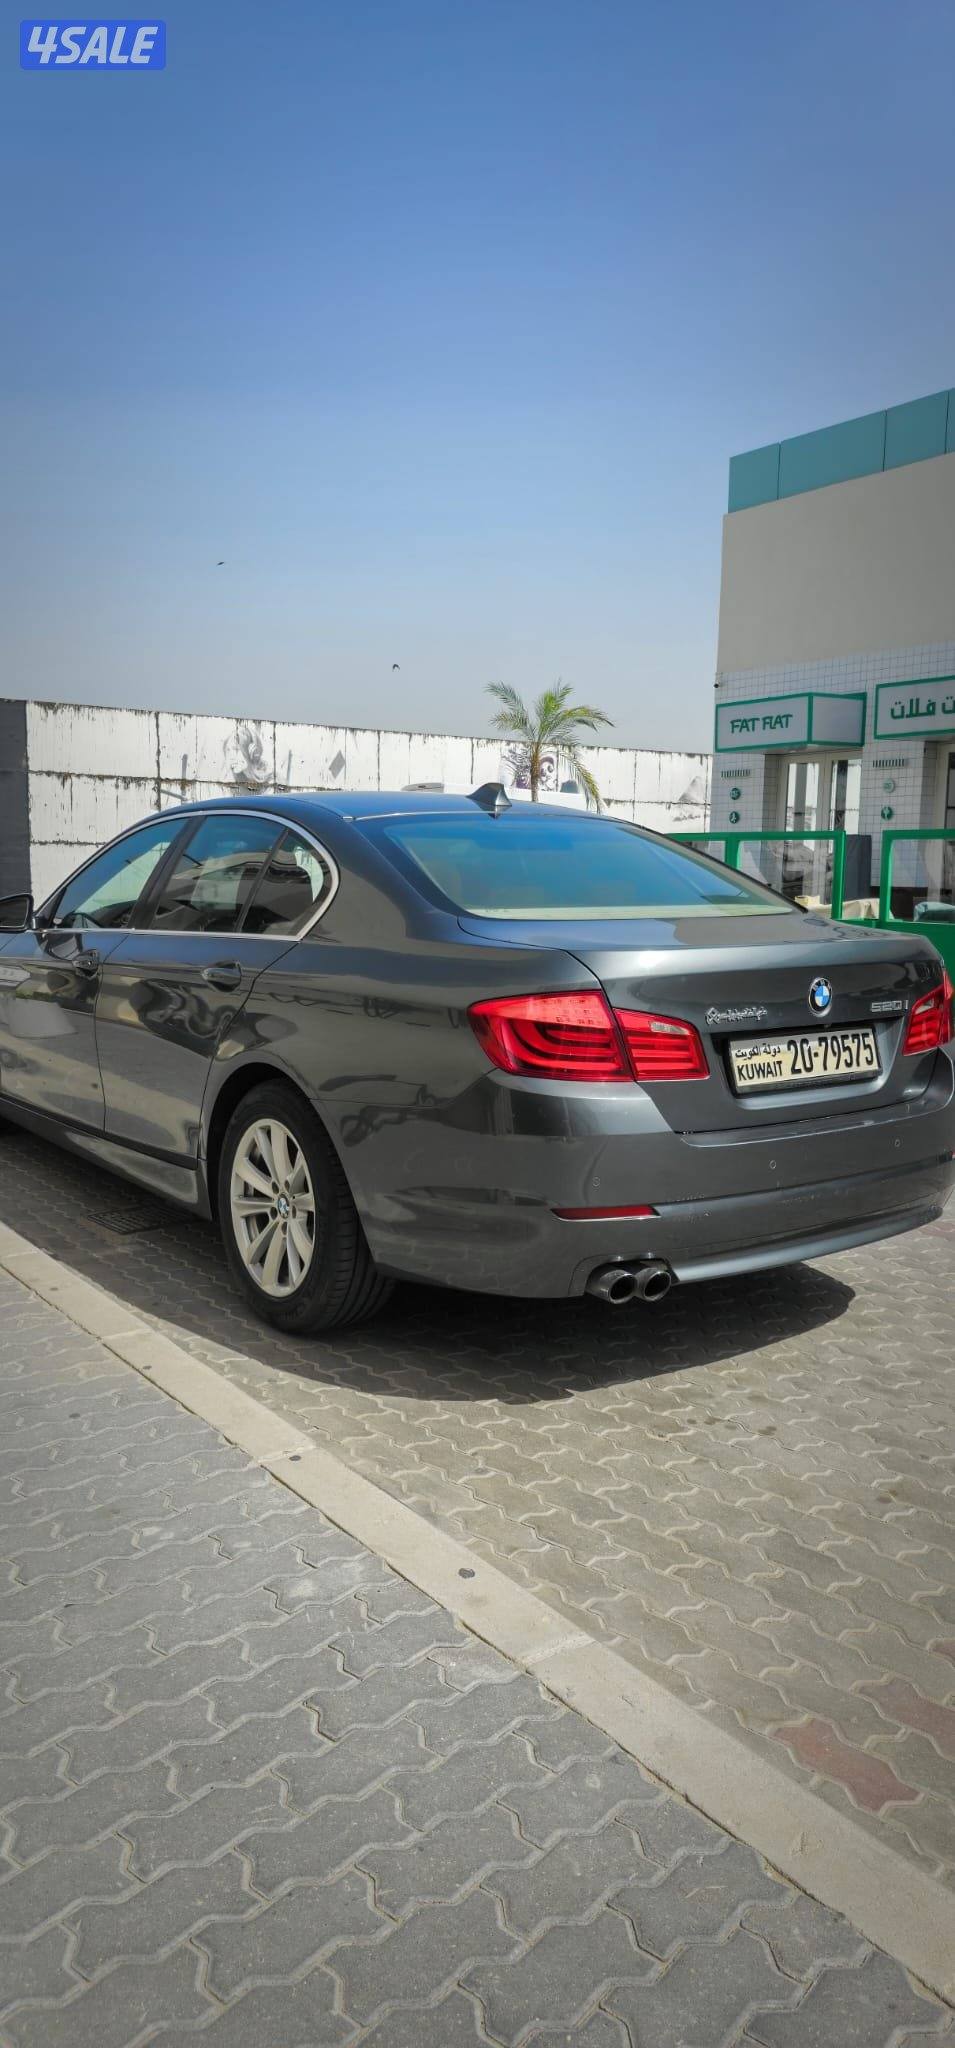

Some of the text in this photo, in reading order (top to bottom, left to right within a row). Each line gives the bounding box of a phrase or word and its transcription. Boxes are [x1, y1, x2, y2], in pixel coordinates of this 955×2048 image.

[891, 698, 936, 719] فلات
[730, 714, 793, 733] FAT FLAT
[735, 1043, 781, 1061] دولة الكويت
[787, 1033, 874, 1074] 20-79575
[737, 1060, 782, 1081] KUWAIT
